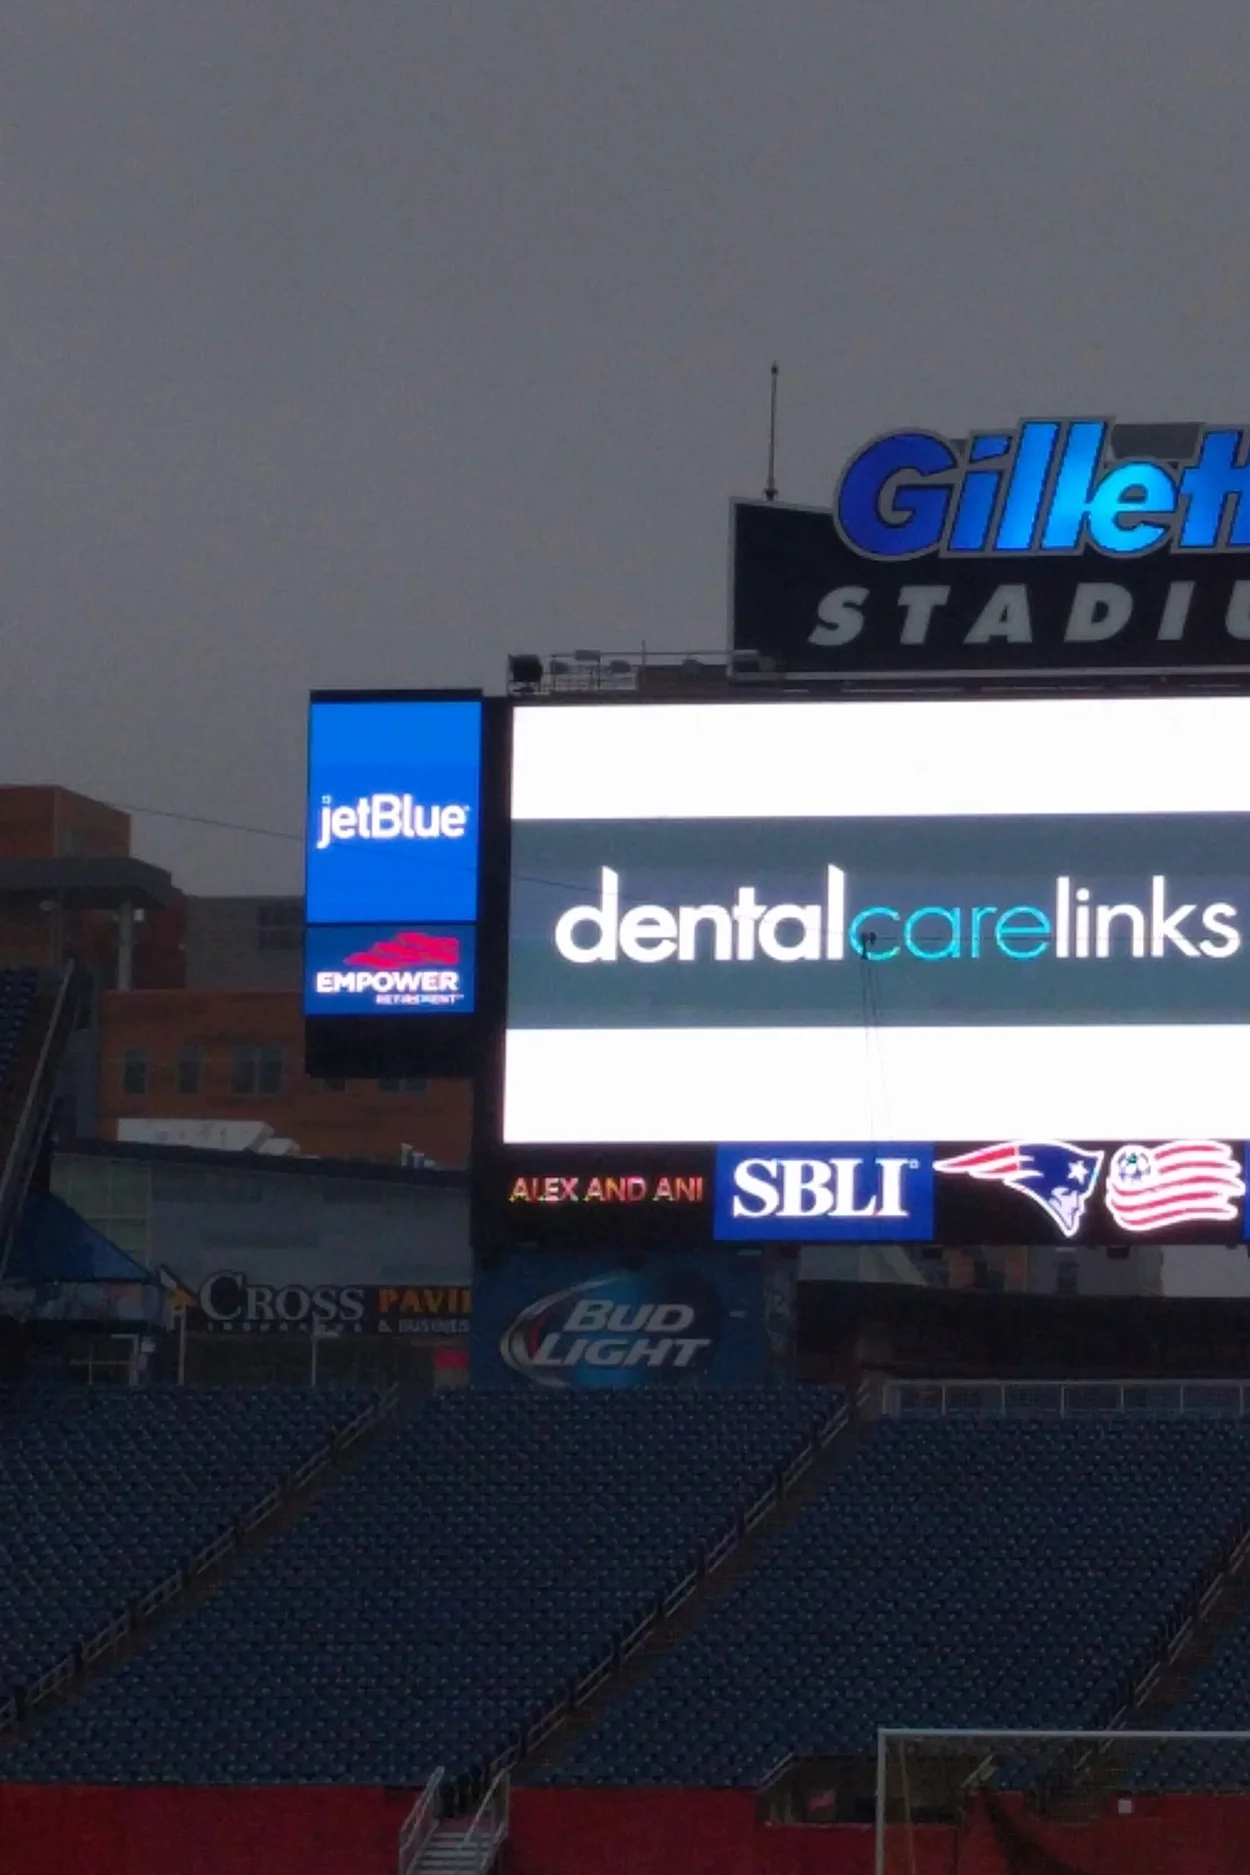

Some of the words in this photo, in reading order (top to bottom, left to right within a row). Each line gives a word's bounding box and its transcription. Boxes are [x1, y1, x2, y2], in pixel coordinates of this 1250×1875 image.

[316, 793, 467, 850] jetBlue
[315, 971, 459, 994] EMPOWER
[509, 1177, 578, 1202] ALEX
[584, 1177, 647, 1201] AND
[653, 1177, 703, 1201] ANI
[732, 1157, 910, 1218] SBLI
[199, 1270, 366, 1322] CROSS
[562, 1298, 695, 1333] BUD
[531, 1331, 712, 1367] LIGHT
